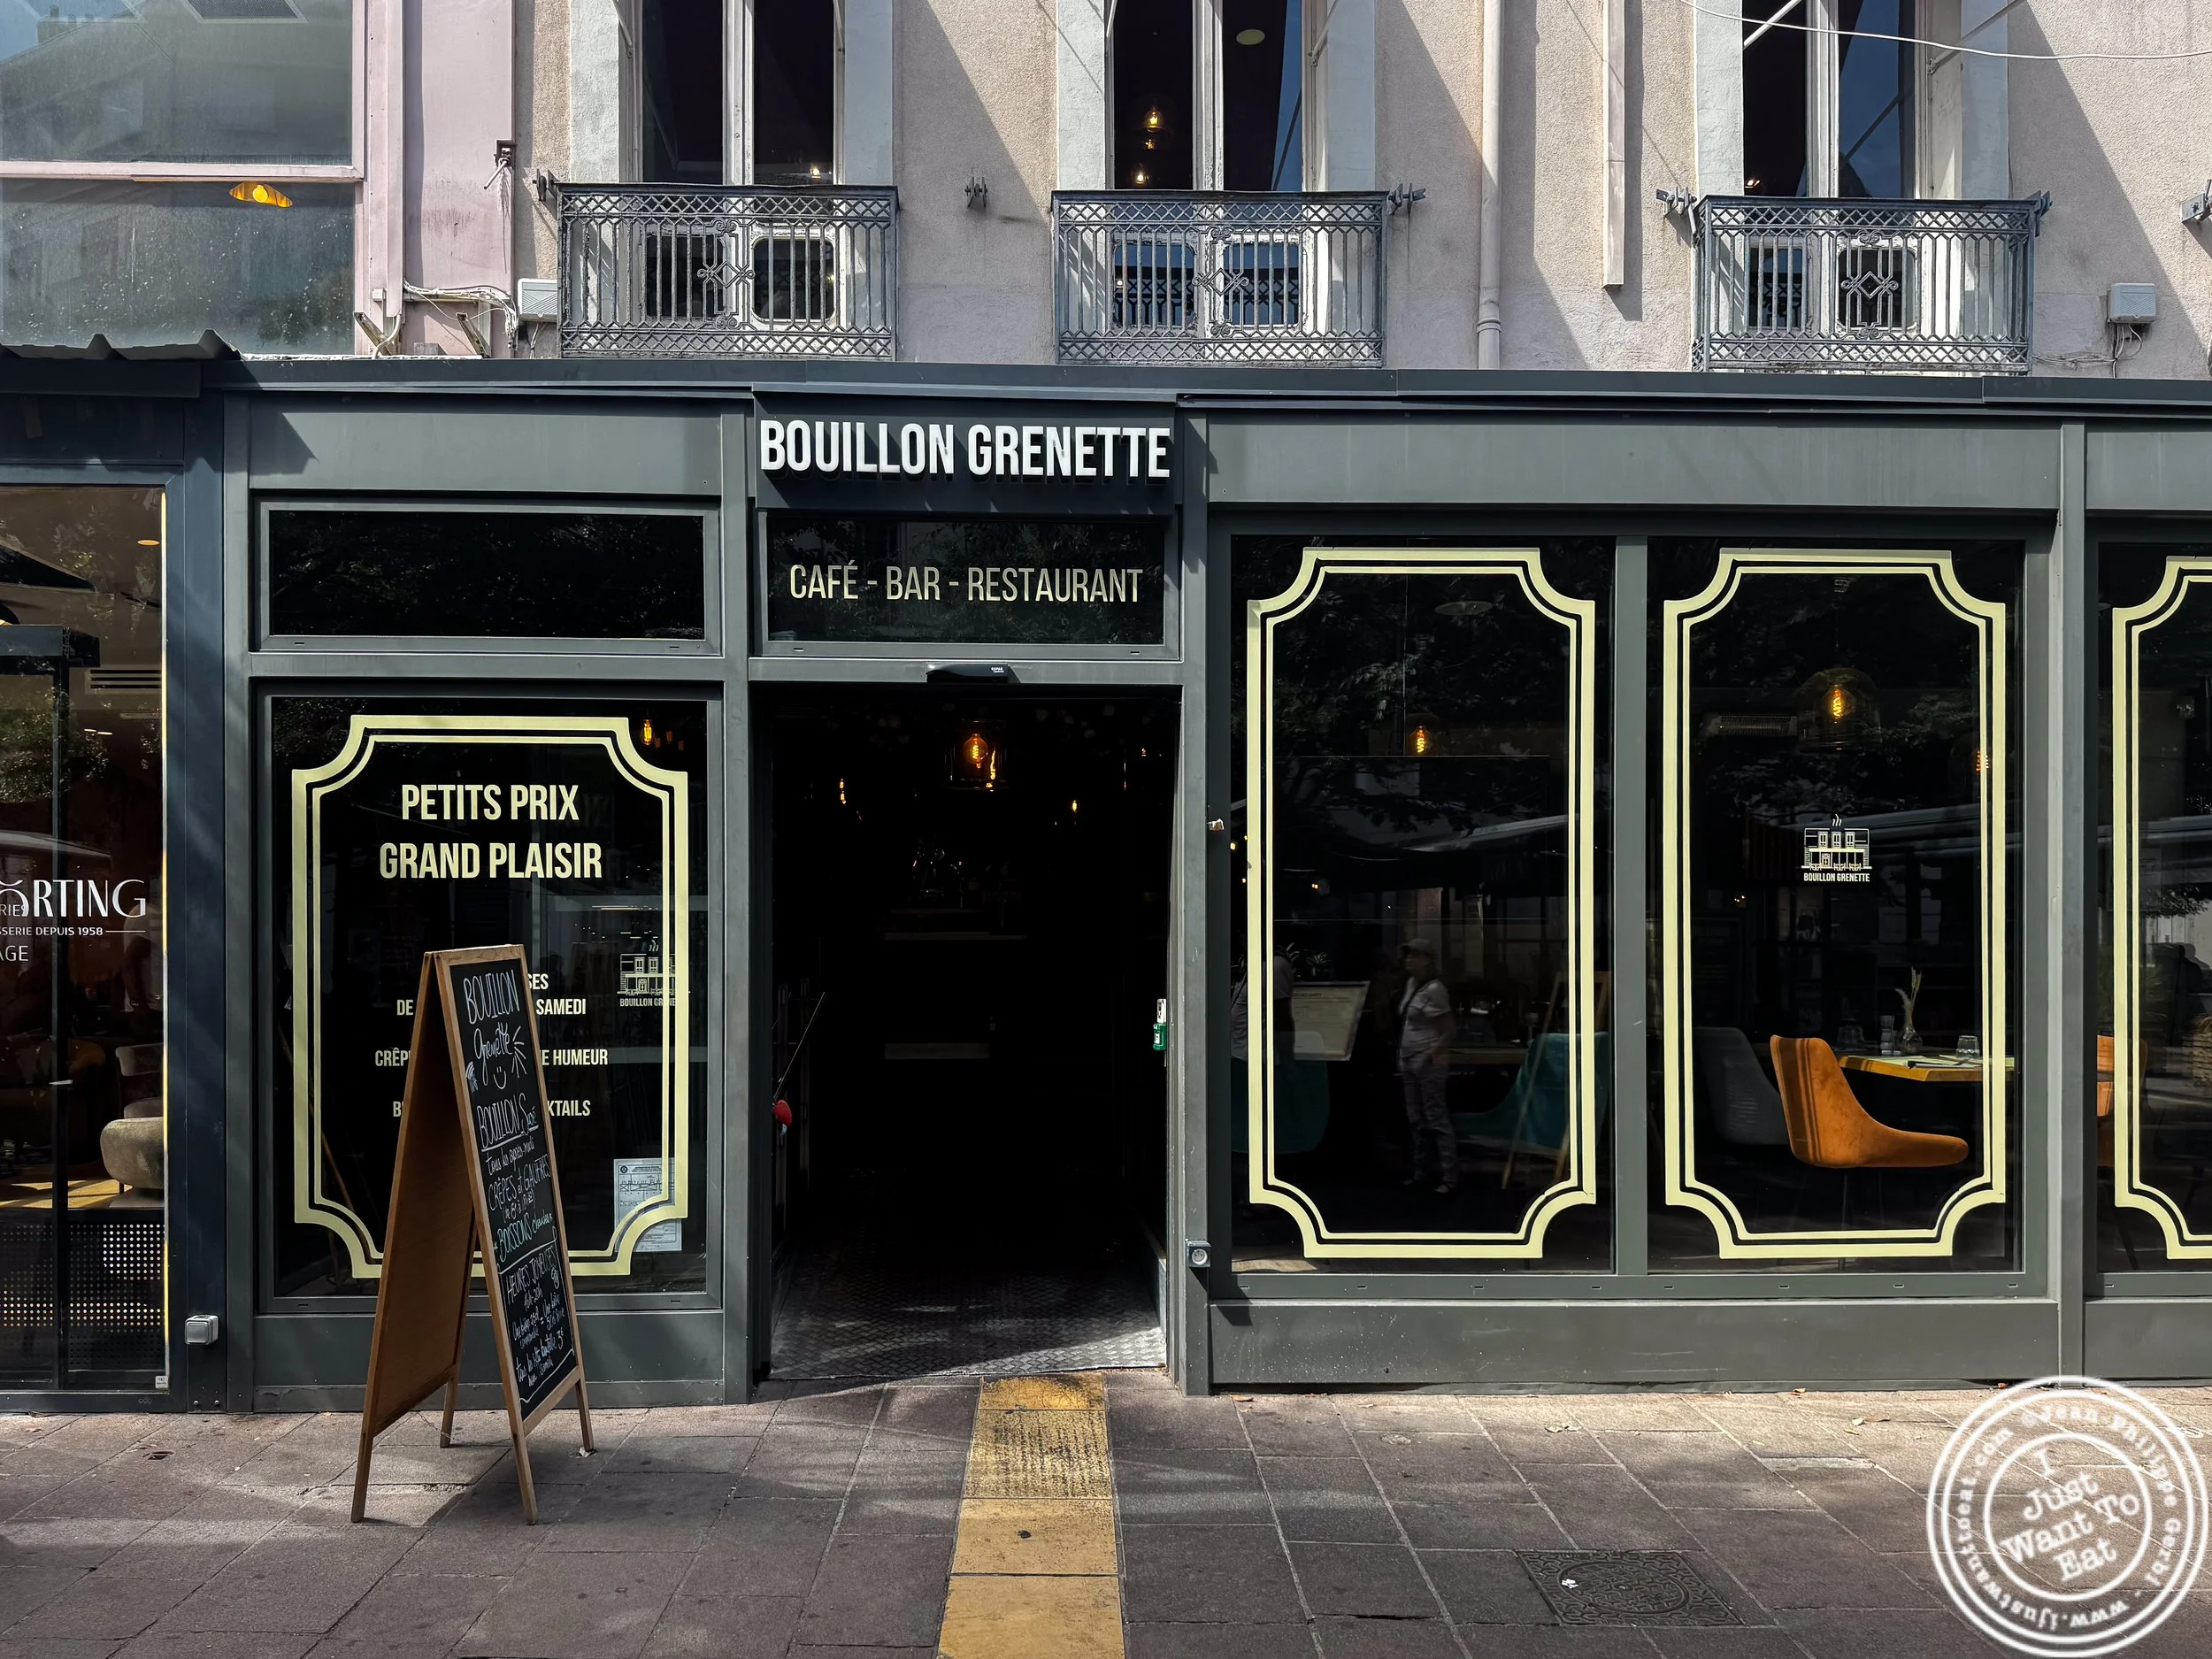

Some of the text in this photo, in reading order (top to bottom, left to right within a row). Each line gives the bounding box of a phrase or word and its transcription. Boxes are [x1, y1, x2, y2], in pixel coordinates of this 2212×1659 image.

[760, 419, 1171, 479] BOUILLON GRENETTE
[789, 559, 858, 600] CAFÉ
[886, 565, 941, 602] BAR
[968, 567, 1144, 603] RESTAURANT
[402, 784, 580, 821] PETITS PRIX
[380, 842, 603, 879] GRAND PLAISIR
[1803, 872, 1870, 882] BOUILLON GRENETTE
[35, 926, 75, 936] DEPUIS
[78, 926, 104, 936] 1958
[396, 999, 587, 1016] DE SAMEDI
[463, 969, 520, 1025] BOUILLON
[619, 997, 653, 1007] BOUILLON
[374, 1047, 411, 1067] CRÊP
[553, 1048, 609, 1066] HUMEUR
[476, 1094, 521, 1148] BOUILLON
